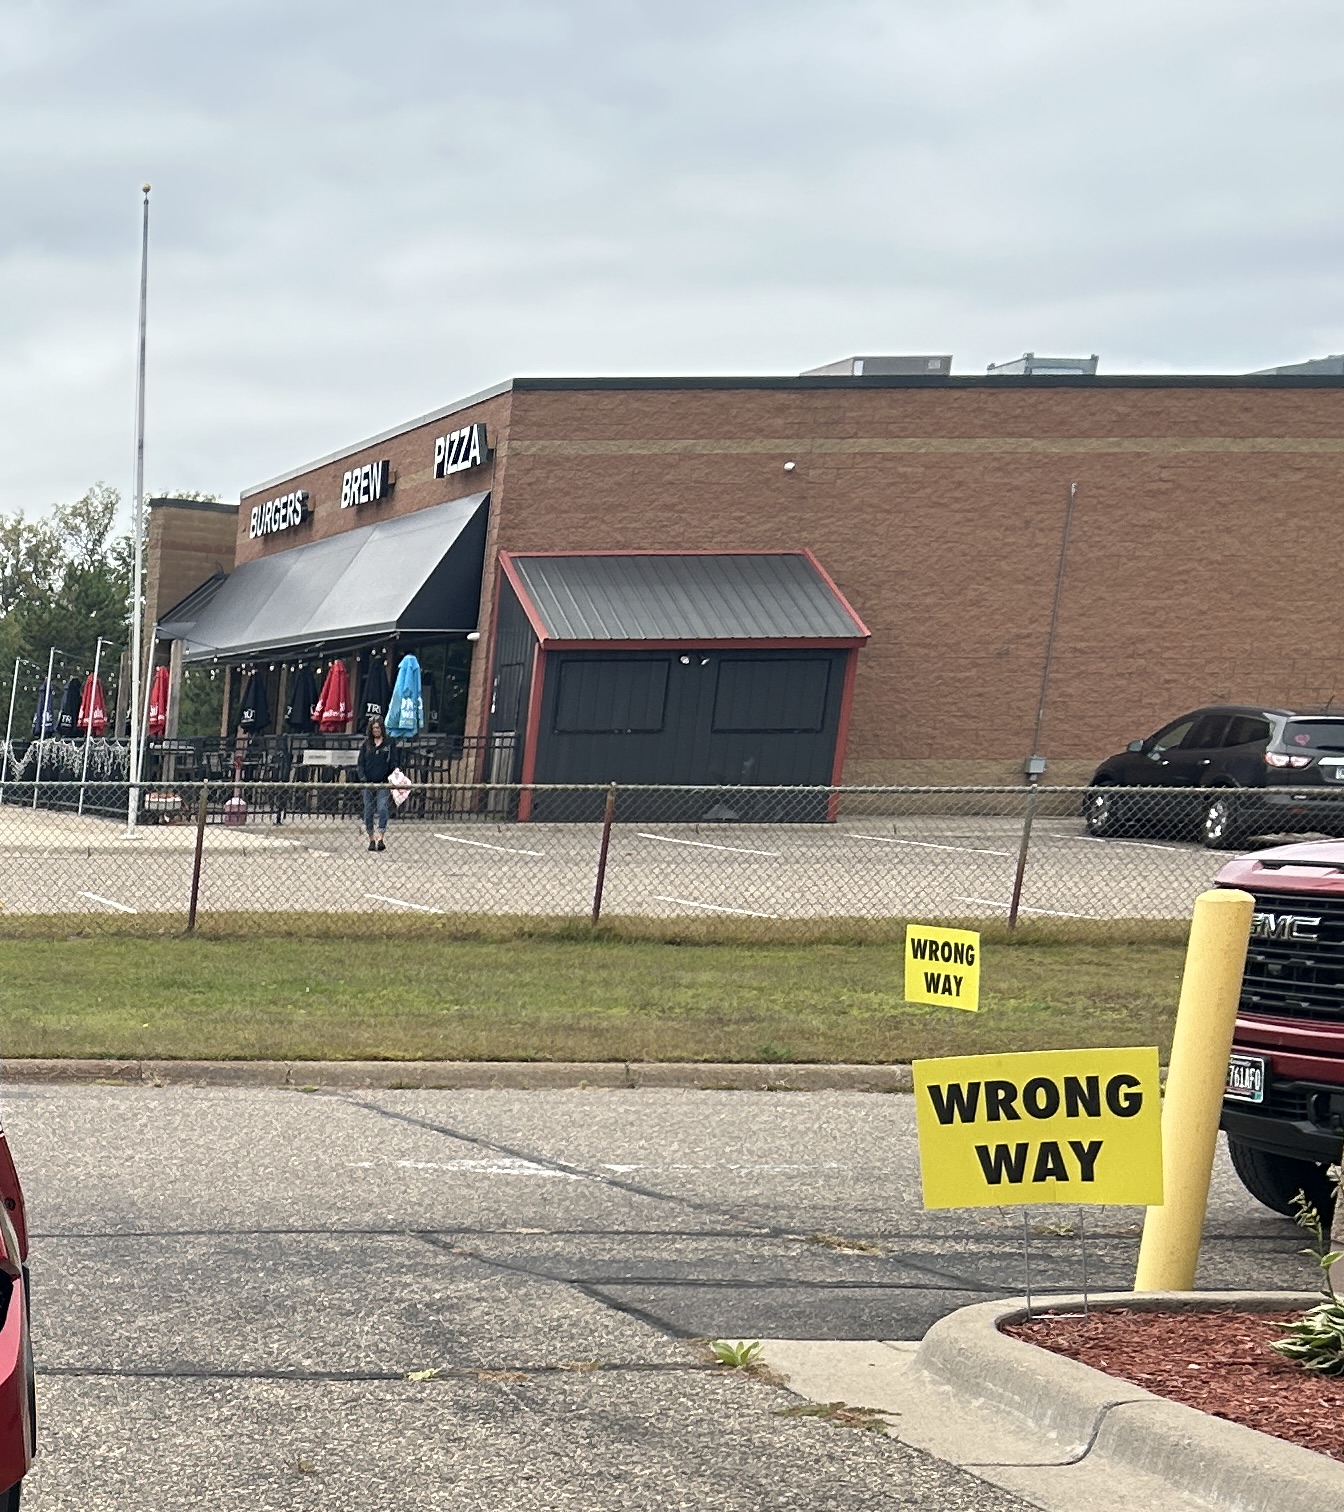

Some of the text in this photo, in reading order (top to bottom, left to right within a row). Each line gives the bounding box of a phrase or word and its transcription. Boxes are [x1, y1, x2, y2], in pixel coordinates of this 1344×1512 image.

[249, 423, 482, 539] BURGERS BREW PIZZA
[911, 937, 975, 967] WRONG
[924, 971, 964, 997] WAY
[927, 1074, 1144, 1125] WRONG
[974, 1140, 1104, 1185] WAY
